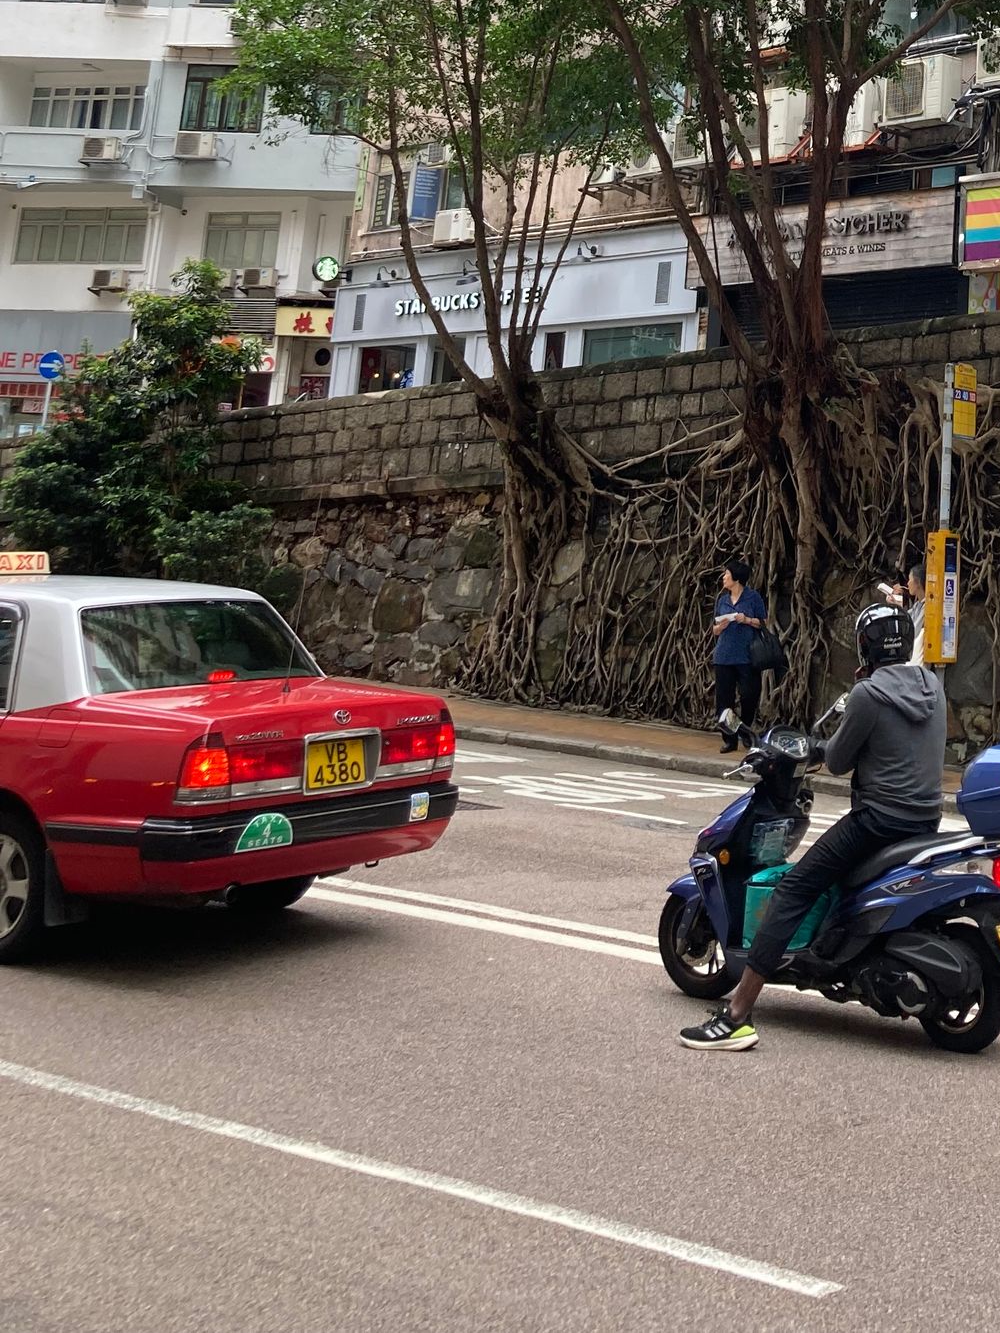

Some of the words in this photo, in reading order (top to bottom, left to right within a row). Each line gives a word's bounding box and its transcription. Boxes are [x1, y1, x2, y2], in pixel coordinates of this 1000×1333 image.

[848, 245, 855, 254] &
[857, 242, 887, 254] WINES
[394, 292, 479, 317] STABUCKS
[325, 742, 348, 763] VB
[314, 761, 361, 786] 4380
[253, 815, 283, 827] TAXI
[262, 823, 271, 838] 4
[247, 835, 283, 848] SEATS
